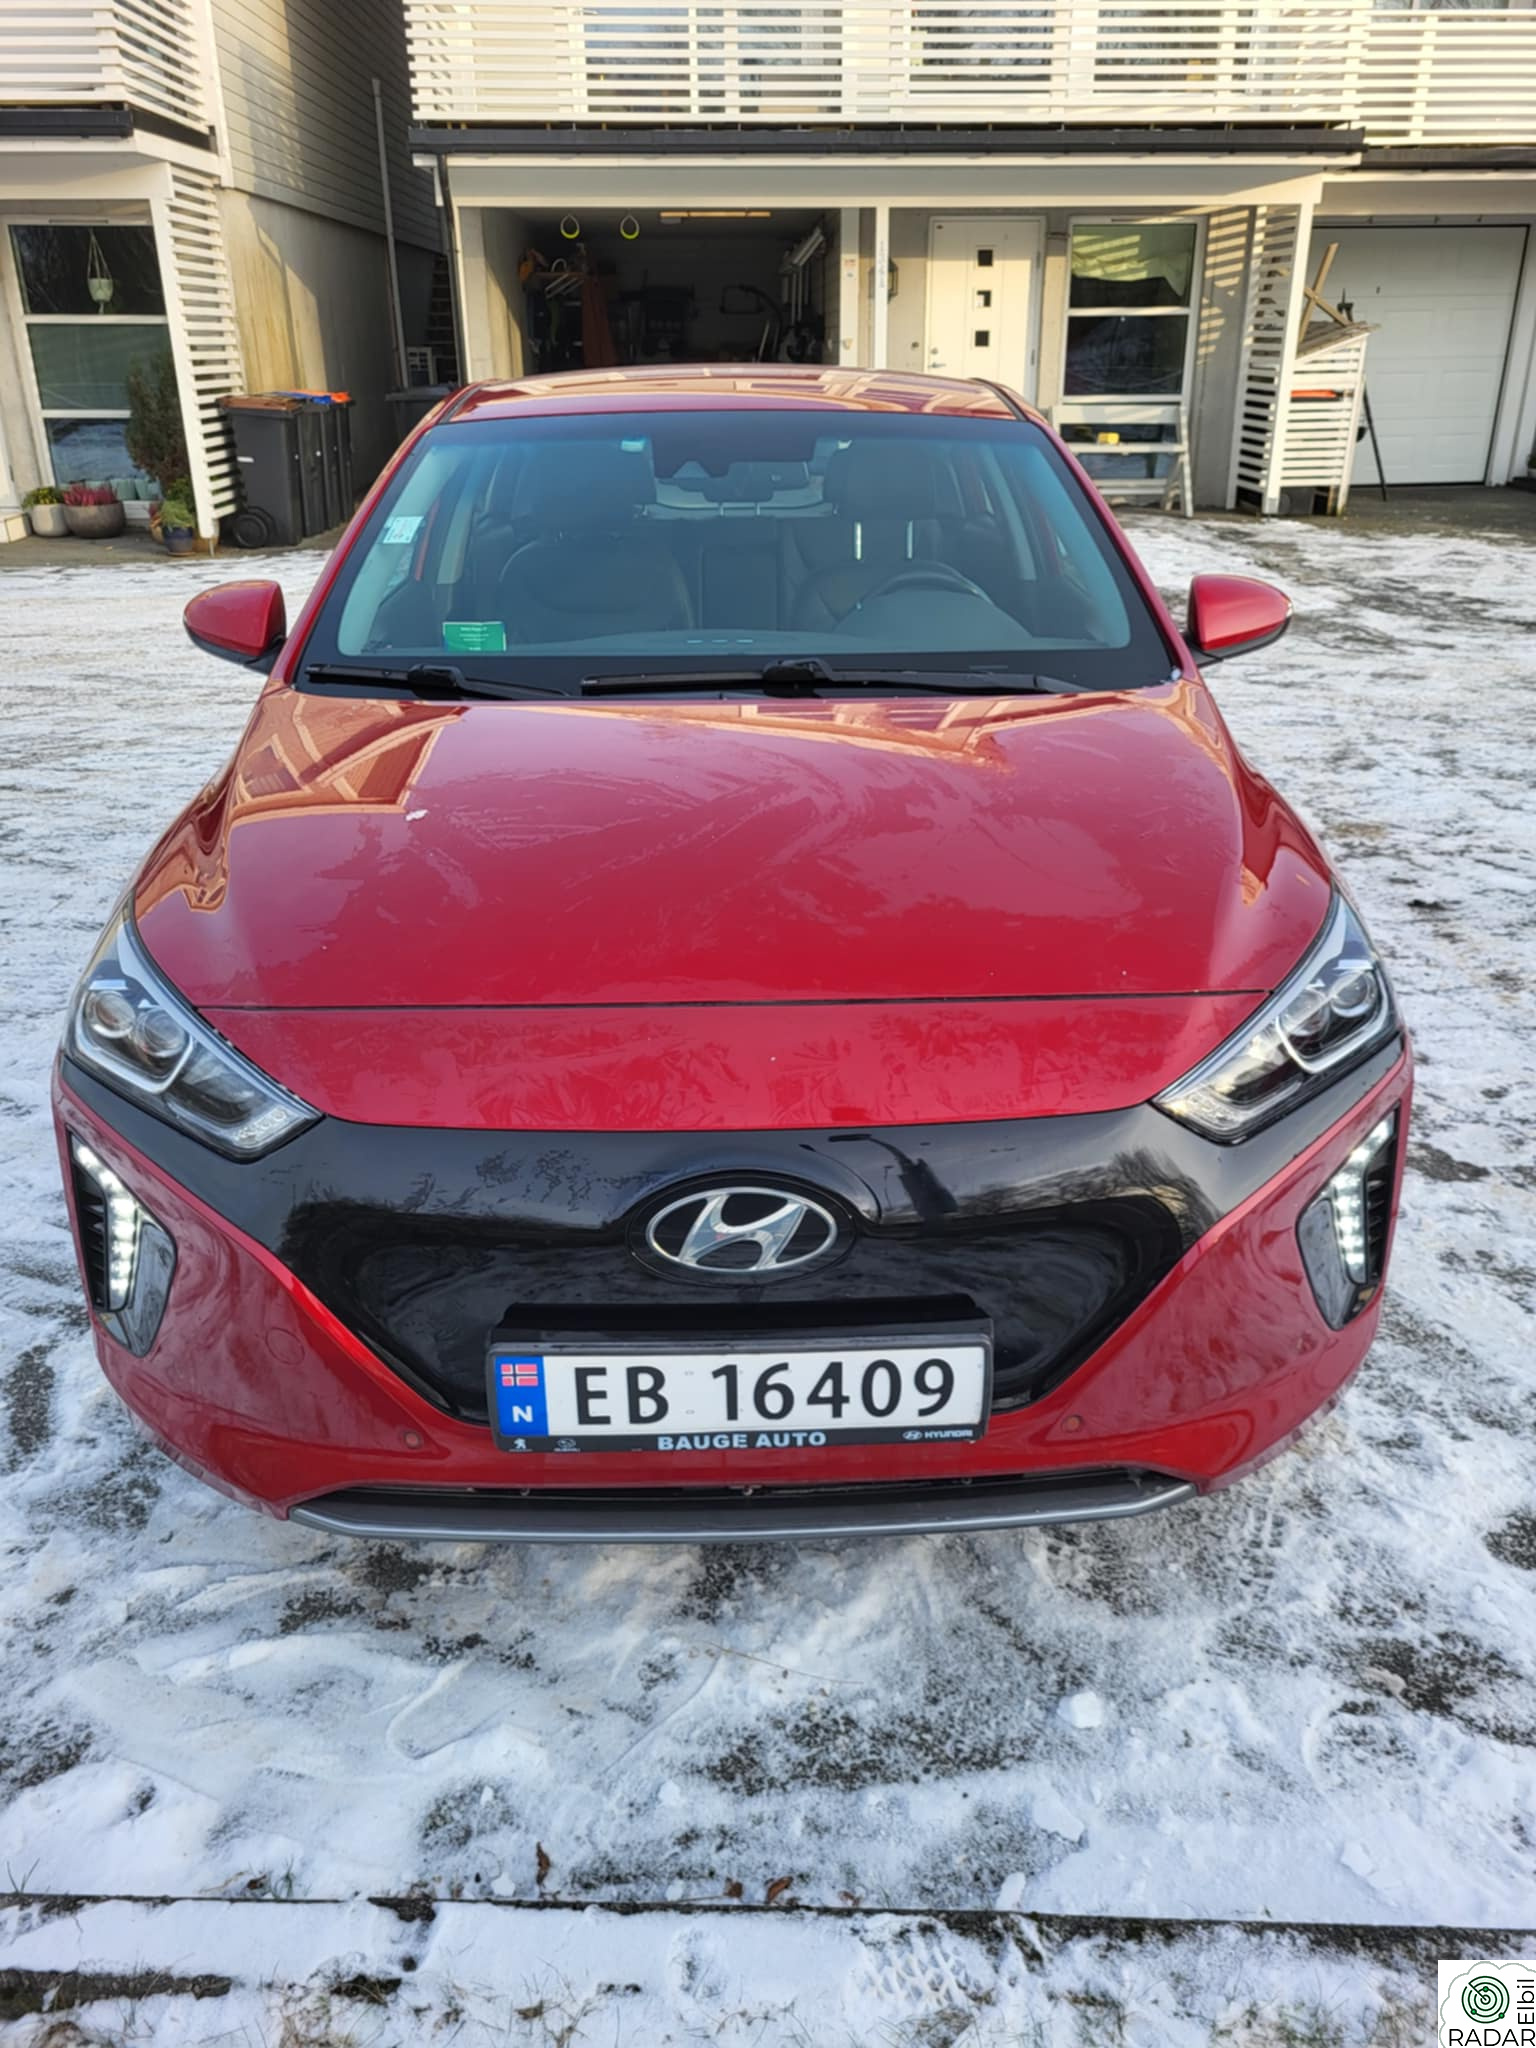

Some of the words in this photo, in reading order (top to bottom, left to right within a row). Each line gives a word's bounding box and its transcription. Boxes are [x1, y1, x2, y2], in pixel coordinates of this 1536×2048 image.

[573, 1365, 670, 1426] EB
[711, 1357, 955, 1421] 16409
[511, 1404, 533, 1423] N
[657, 1433, 748, 1450] BAUGE
[755, 1431, 827, 1448] AUTO
[924, 1429, 973, 1439] HYUNDAI
